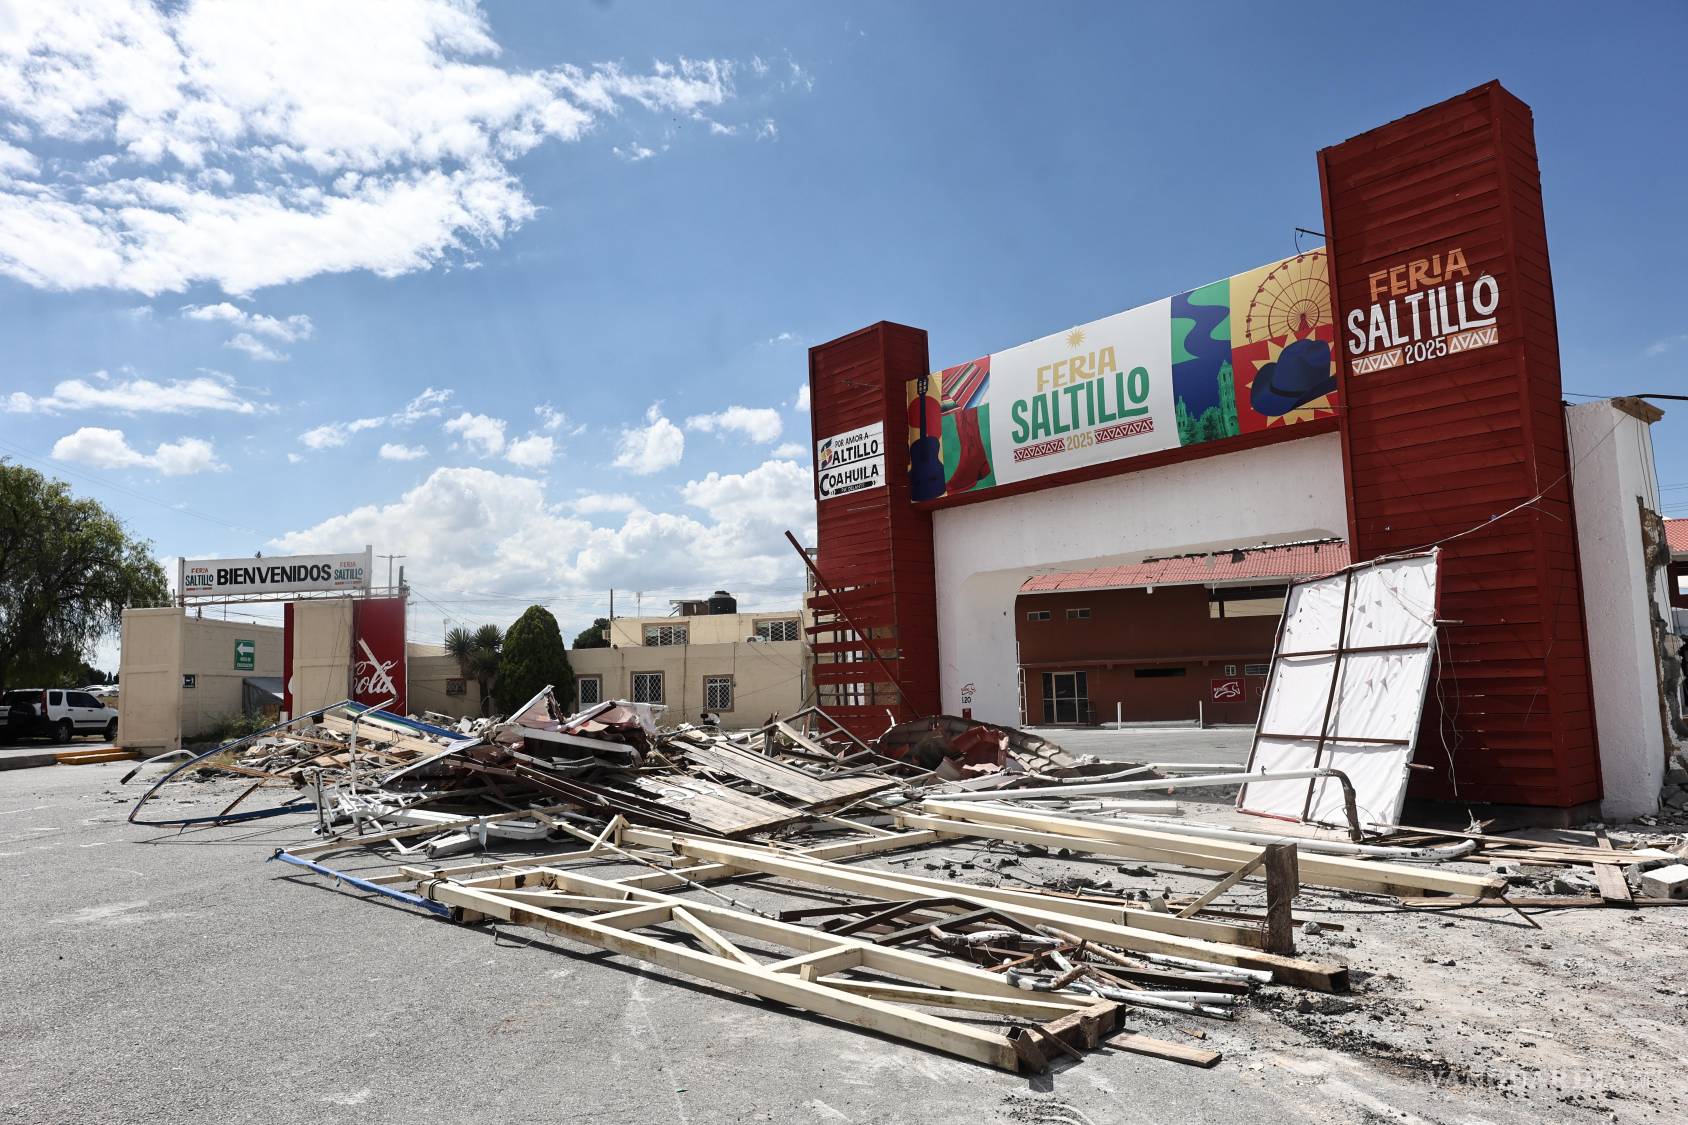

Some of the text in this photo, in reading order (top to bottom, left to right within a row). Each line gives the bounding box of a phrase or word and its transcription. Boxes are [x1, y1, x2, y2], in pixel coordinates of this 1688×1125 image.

[1369, 248, 1471, 302] FERIA
[1347, 275, 1500, 355] SALTILLO
[1404, 336, 1448, 365] 2025
[1036, 345, 1117, 393] FERIA
[1011, 366, 1150, 444] SALTILLO
[835, 432, 869, 448] POR AMOR A
[1066, 431, 1094, 451] 2025
[820, 464, 879, 497] COAHUILA
[185, 574, 214, 587] SALTILLO
[217, 563, 332, 586] BIENVENIDOS
[334, 567, 363, 581] SALTILLO
